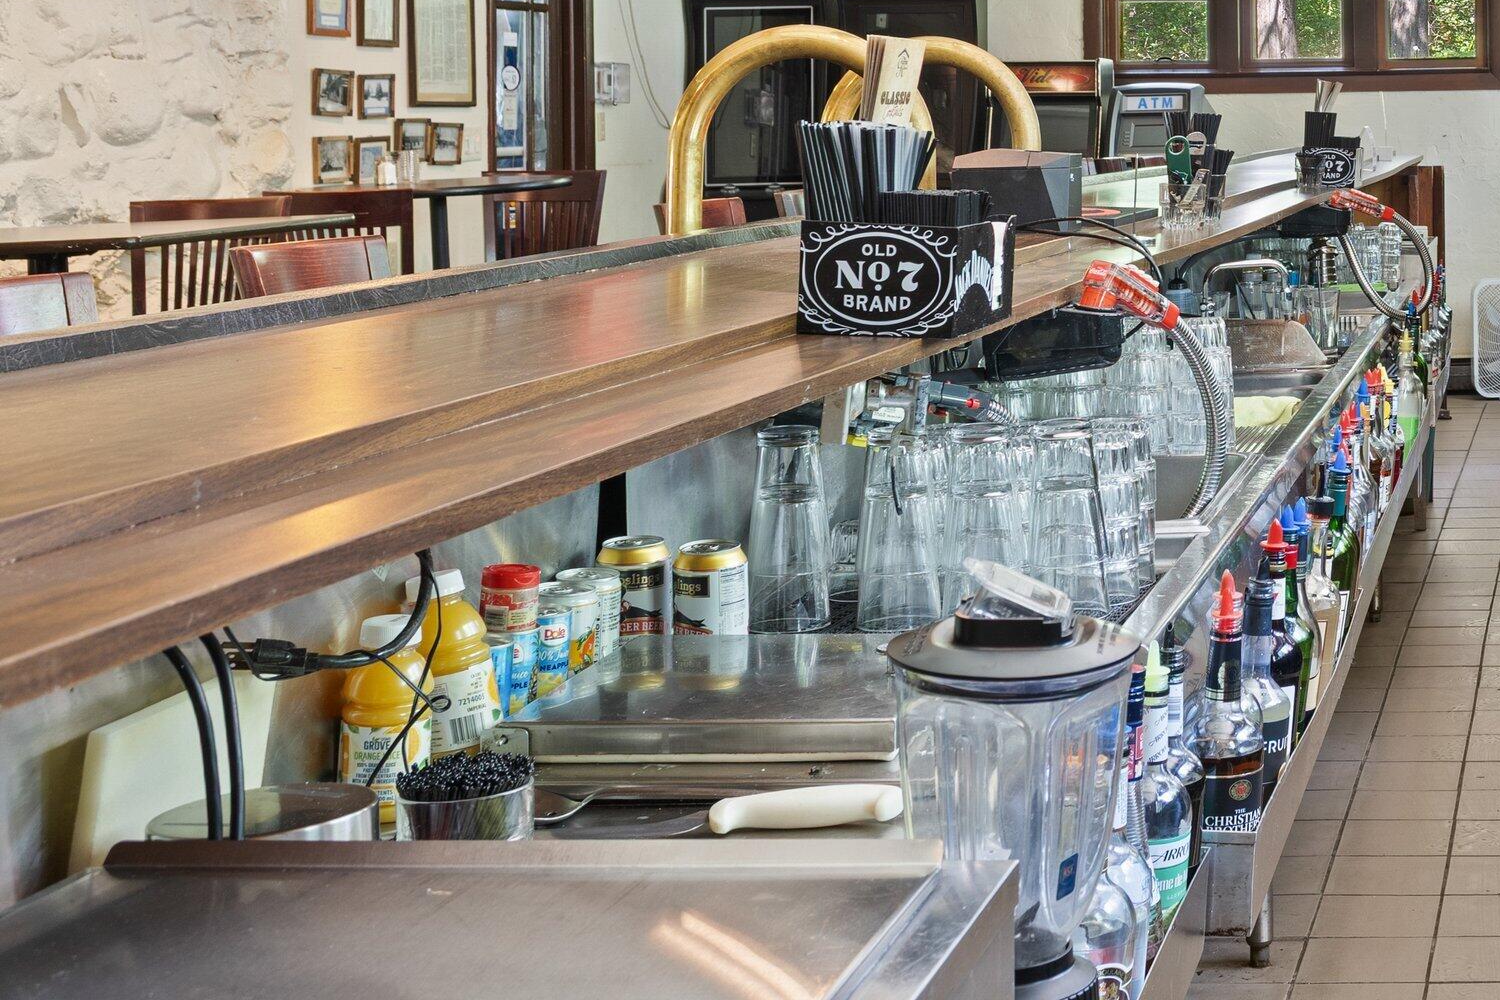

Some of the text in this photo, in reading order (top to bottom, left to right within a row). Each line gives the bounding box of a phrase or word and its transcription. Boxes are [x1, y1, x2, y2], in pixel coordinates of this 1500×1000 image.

[880, 91, 911, 105] CLASSIC
[1138, 97, 1173, 110] ATM
[861, 243, 898, 258] OLD
[897, 260, 925, 293] 7
[843, 294, 912, 313] BRAND
[620, 572, 660, 588] oslings
[677, 579, 702, 596] lings
[544, 626, 566, 641] Dole
[620, 620, 640, 633] GER
[363, 740, 391, 751] GROVE
[1204, 806, 1261, 827] CHRISTIAN
[1152, 843, 1189, 864] ARRO
